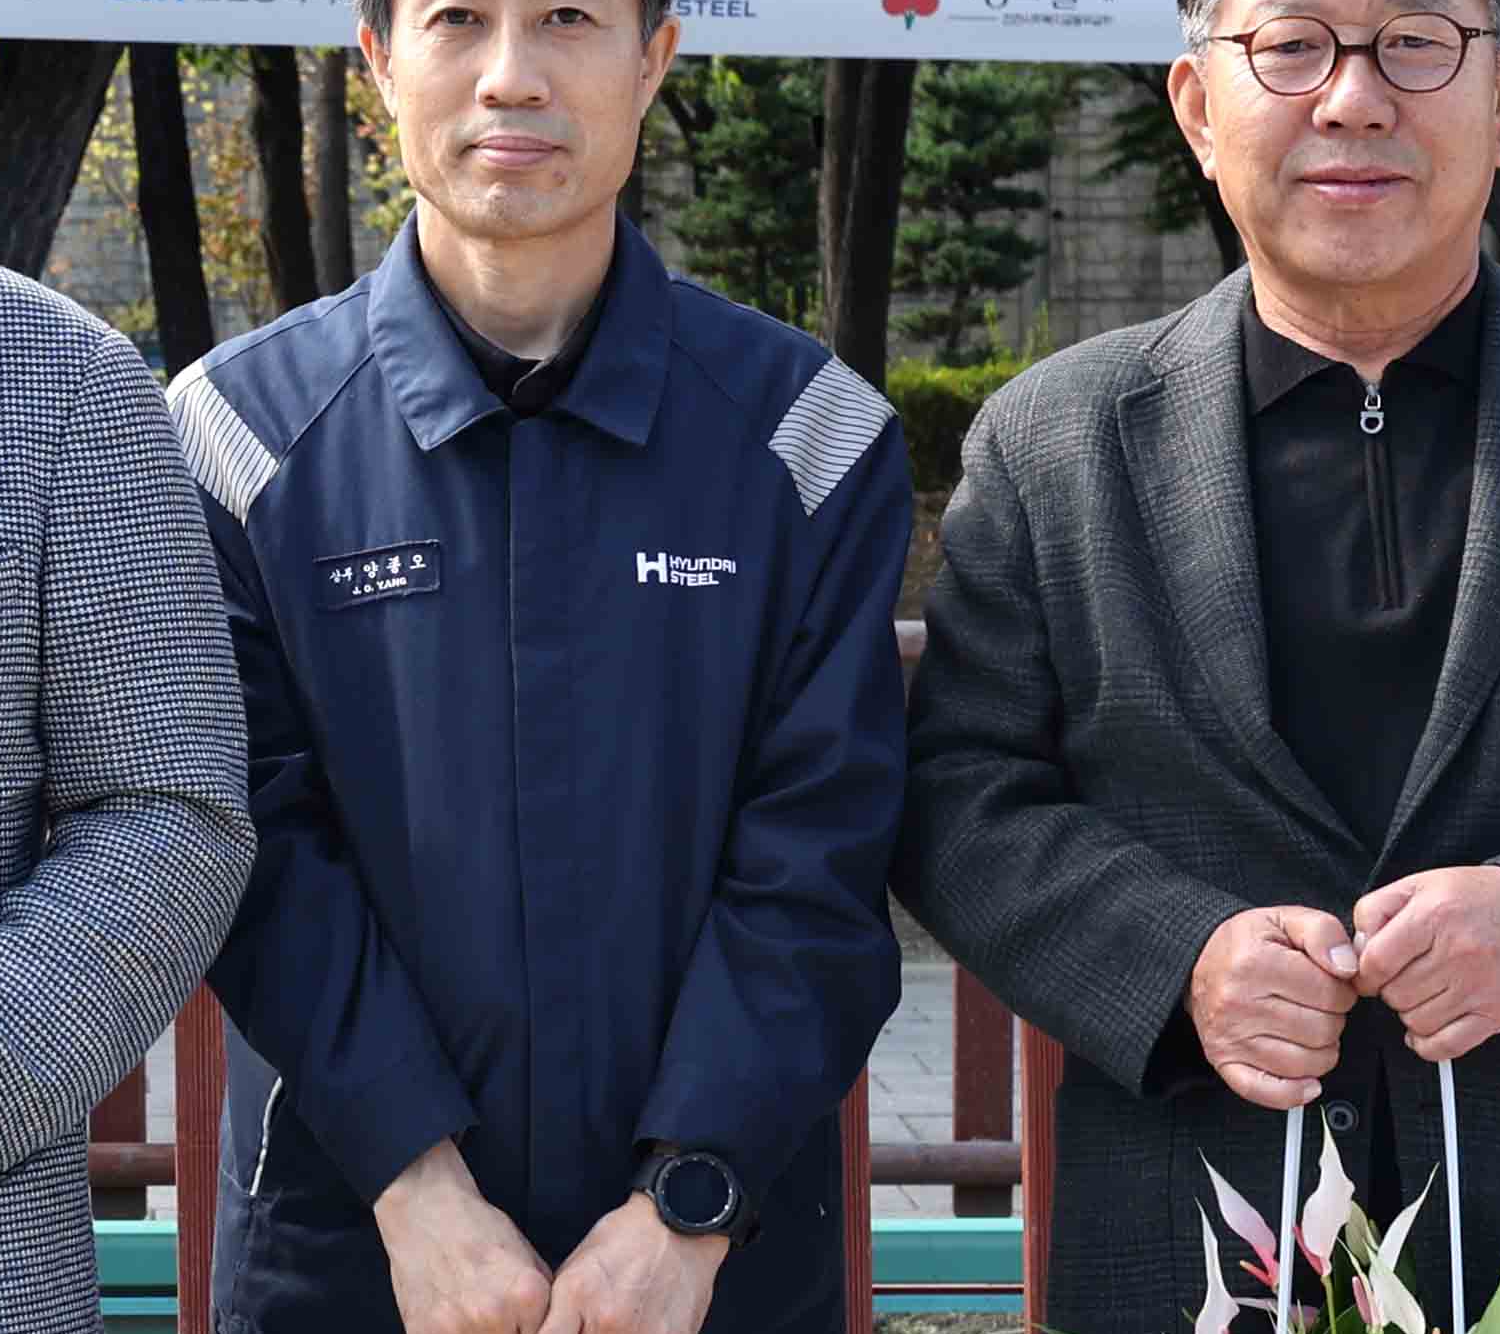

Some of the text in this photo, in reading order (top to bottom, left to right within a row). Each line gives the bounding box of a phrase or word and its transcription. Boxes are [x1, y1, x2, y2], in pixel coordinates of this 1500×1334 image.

[676, 0, 757, 17] STEEL
[669, 555, 737, 574] HYUNDAI
[670, 570, 720, 586] STEEL
